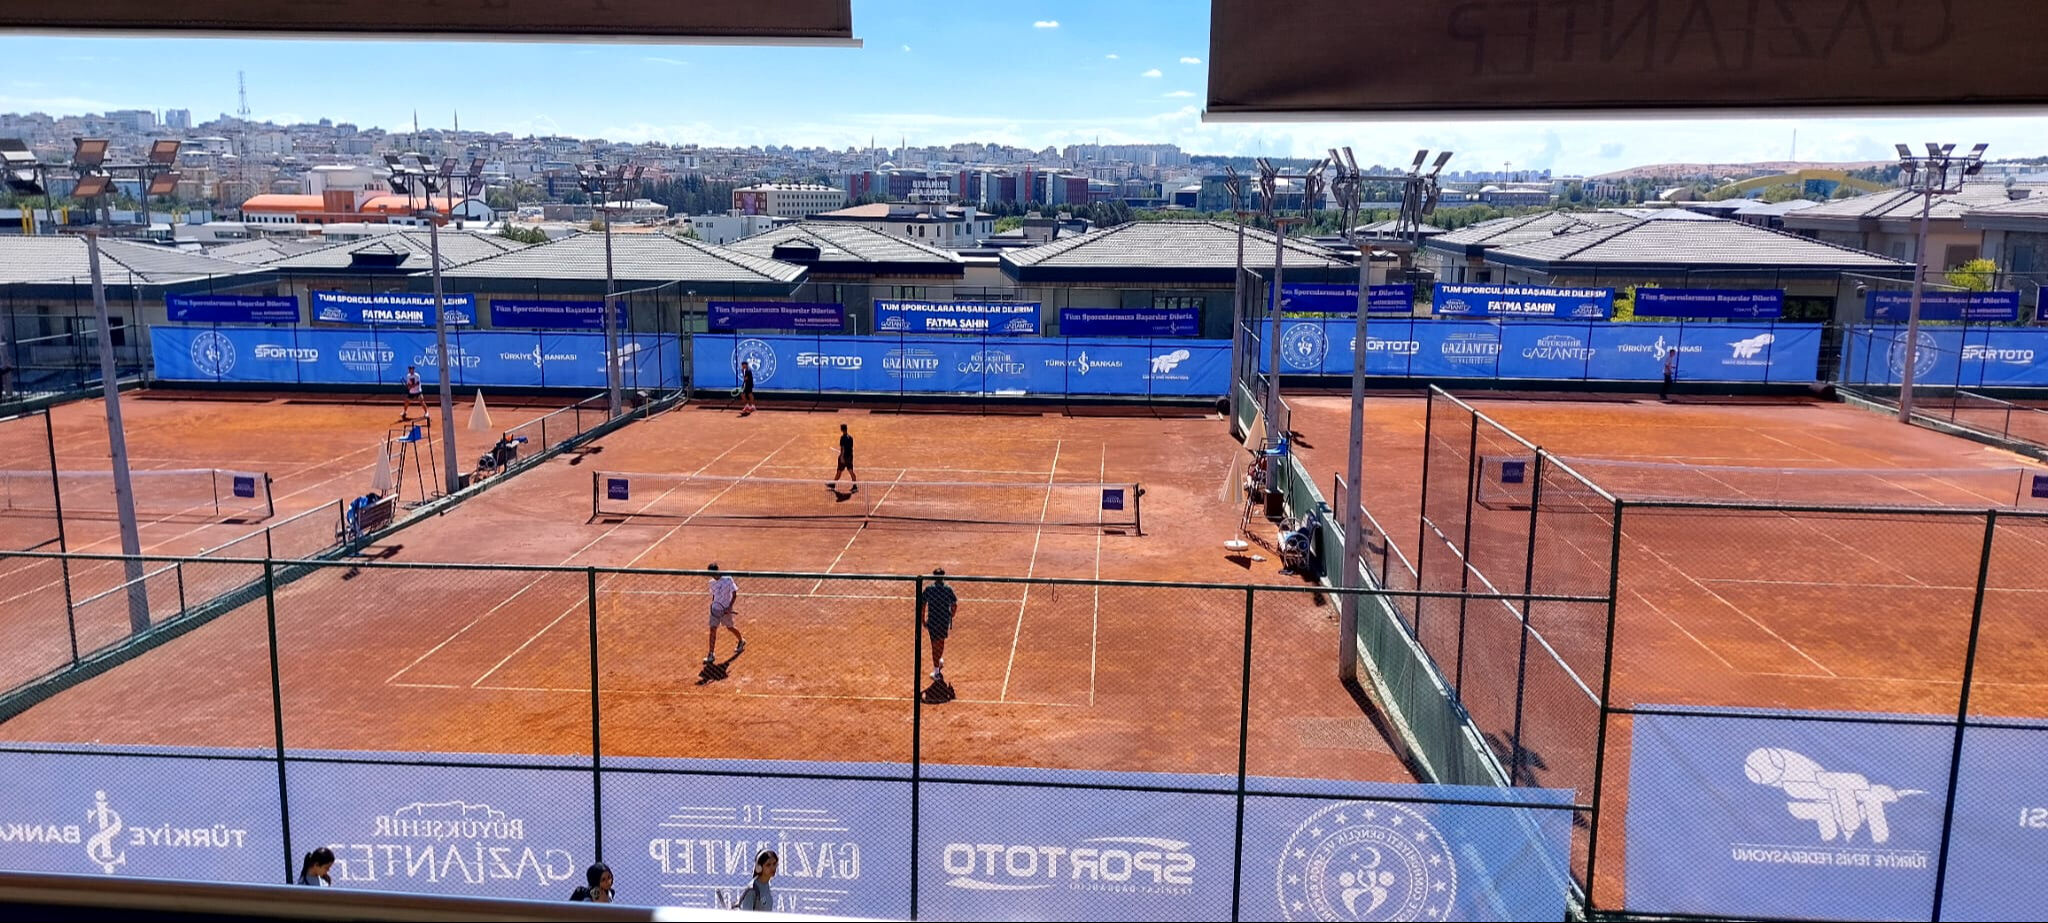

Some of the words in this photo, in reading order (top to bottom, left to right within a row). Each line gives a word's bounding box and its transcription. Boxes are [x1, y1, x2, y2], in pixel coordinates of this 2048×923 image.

[1488, 301, 1521, 311] FATMA
[362, 310, 394, 319] FATMA
[926, 318, 958, 327] FATMA
